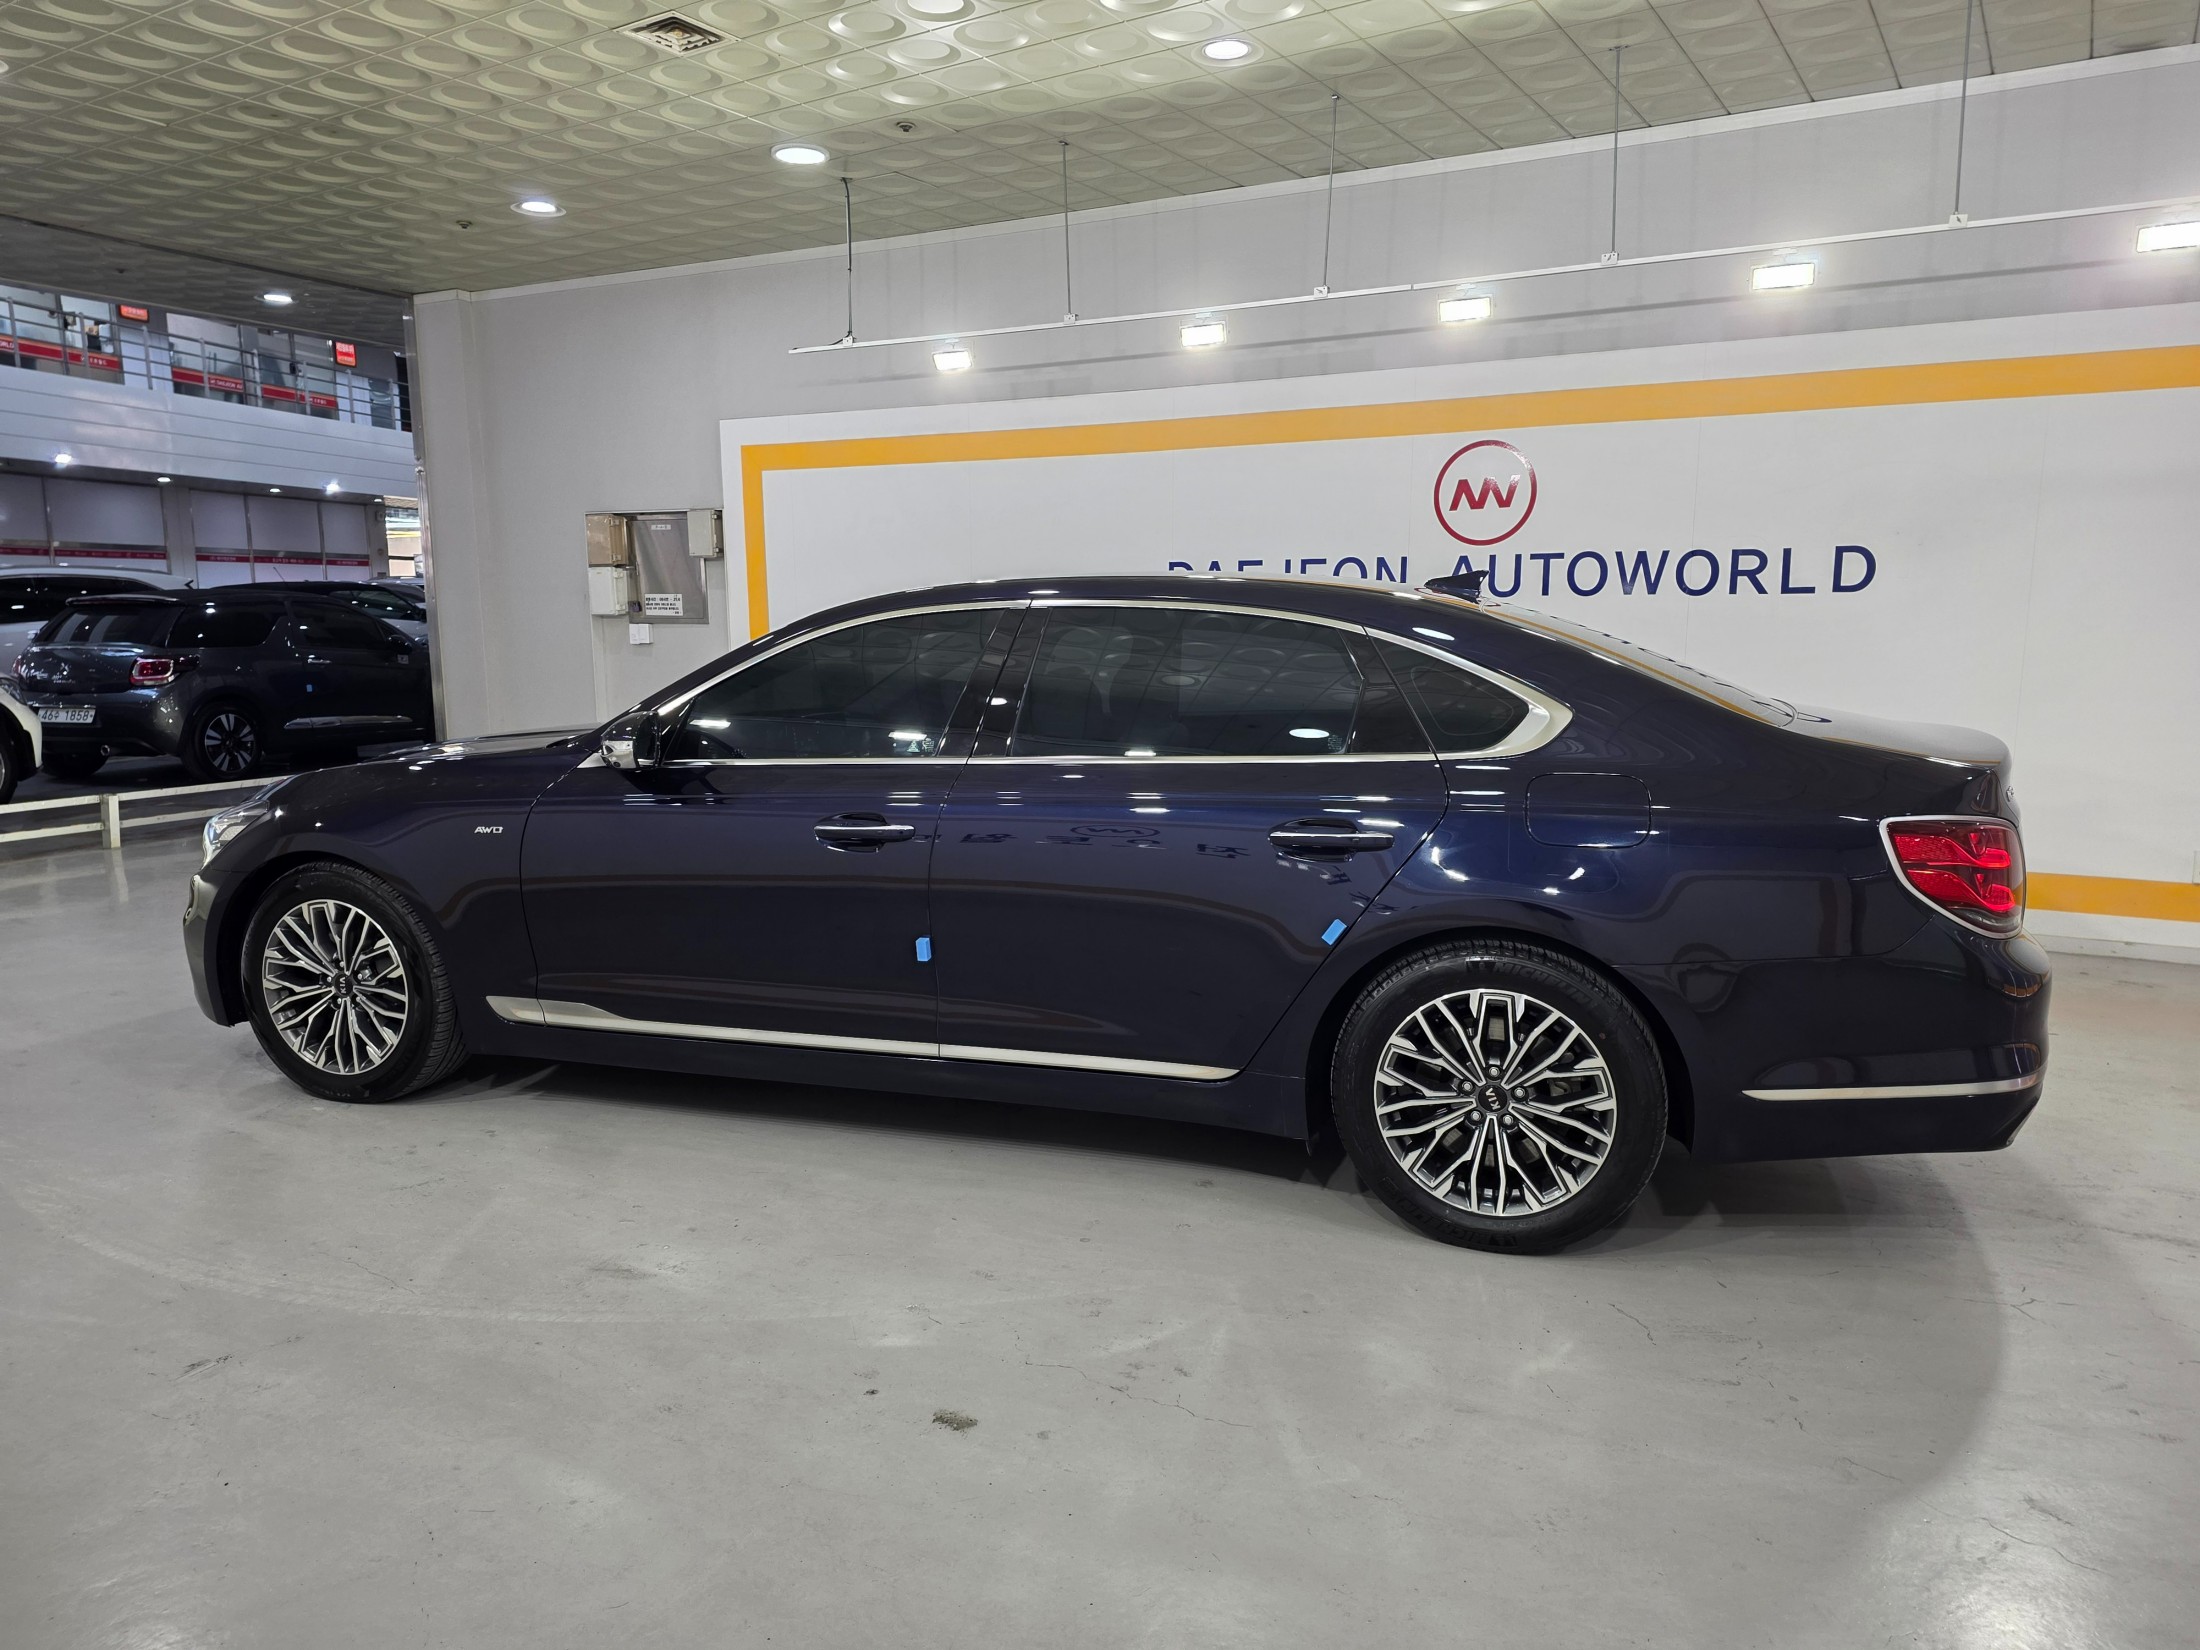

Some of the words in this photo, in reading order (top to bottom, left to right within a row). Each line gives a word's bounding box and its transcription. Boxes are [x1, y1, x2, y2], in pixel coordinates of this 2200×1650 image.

[65, 709, 90, 722] 1858
[339, 976, 347, 994] KIA
[1485, 1087, 1502, 1111] KIA
